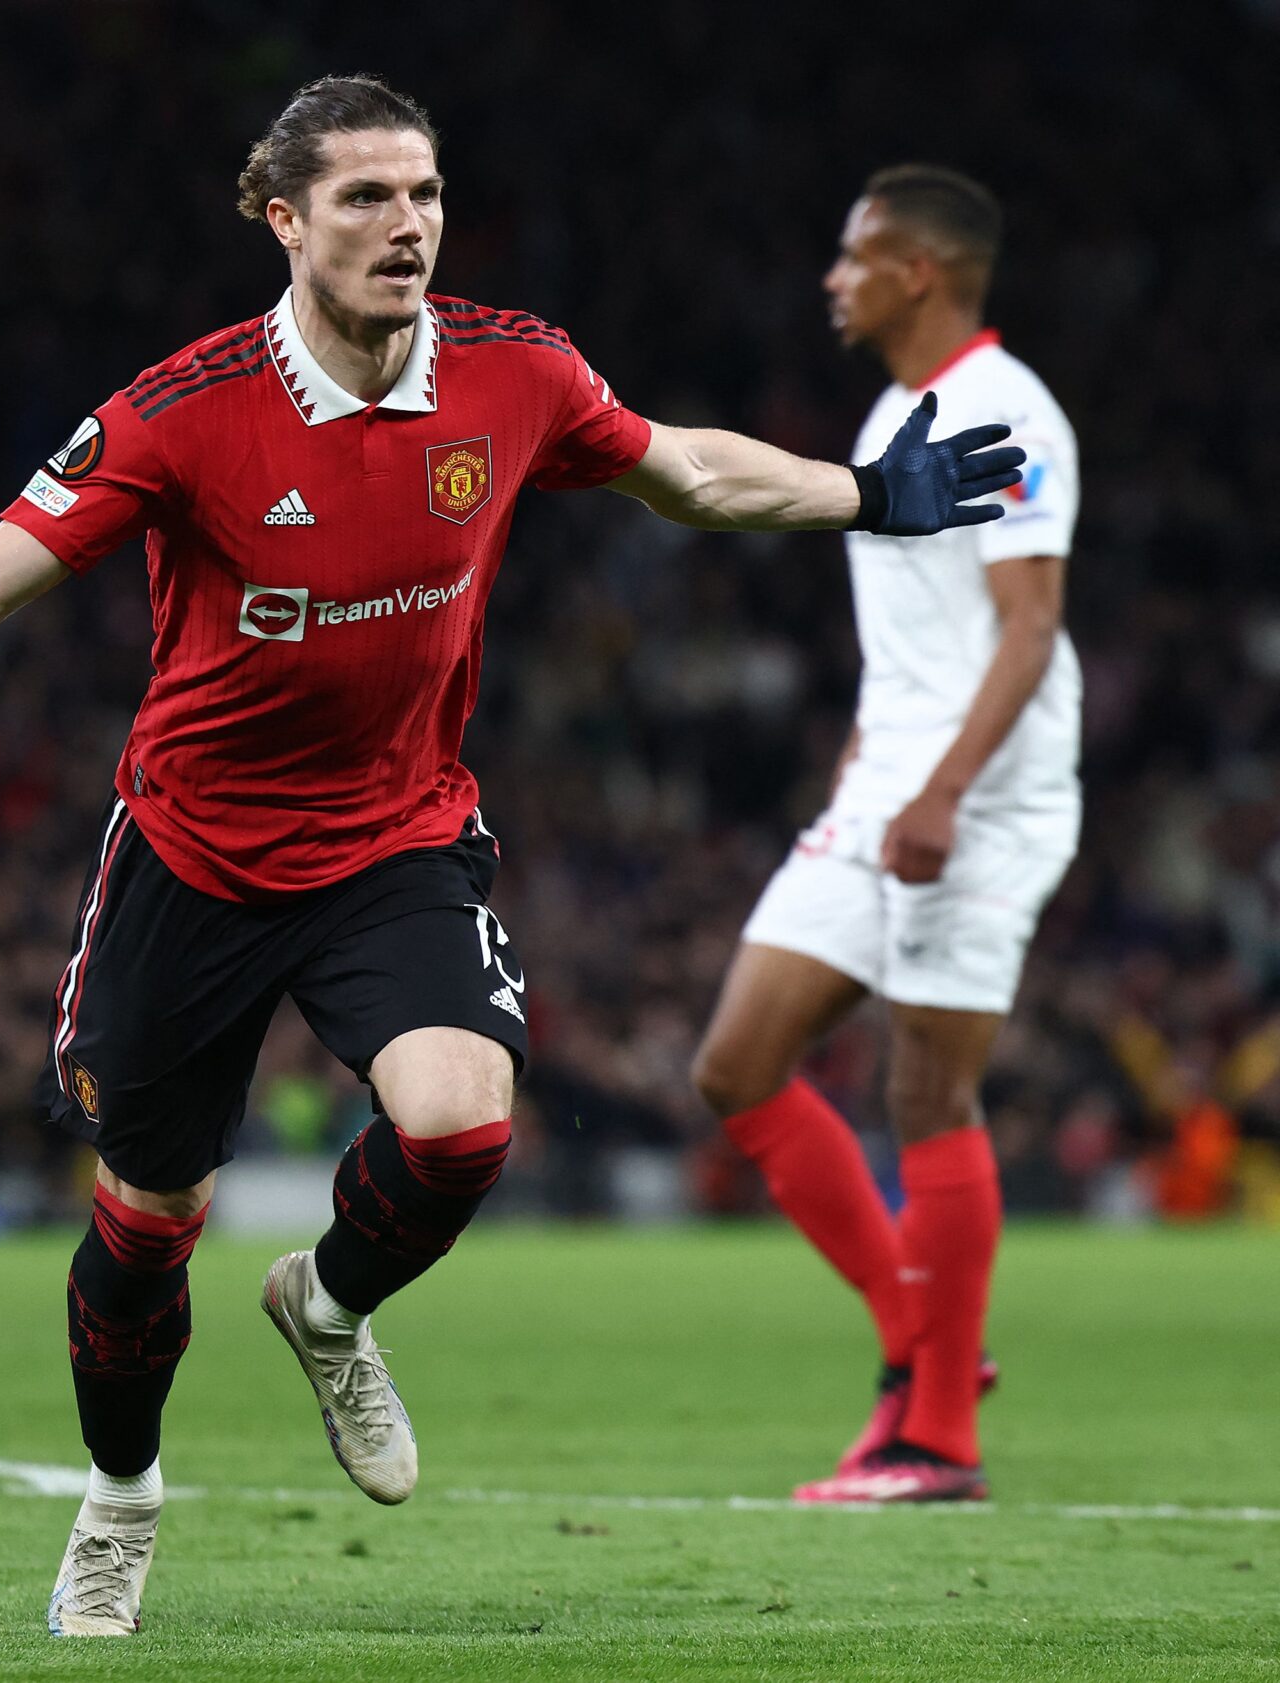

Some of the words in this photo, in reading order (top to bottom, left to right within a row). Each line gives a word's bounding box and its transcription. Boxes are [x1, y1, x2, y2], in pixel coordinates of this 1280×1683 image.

[439, 454, 481, 478] MANCHESTER
[447, 493, 477, 507] UNITED
[263, 511, 316, 526] adidas
[313, 566, 477, 626] TeamViewer
